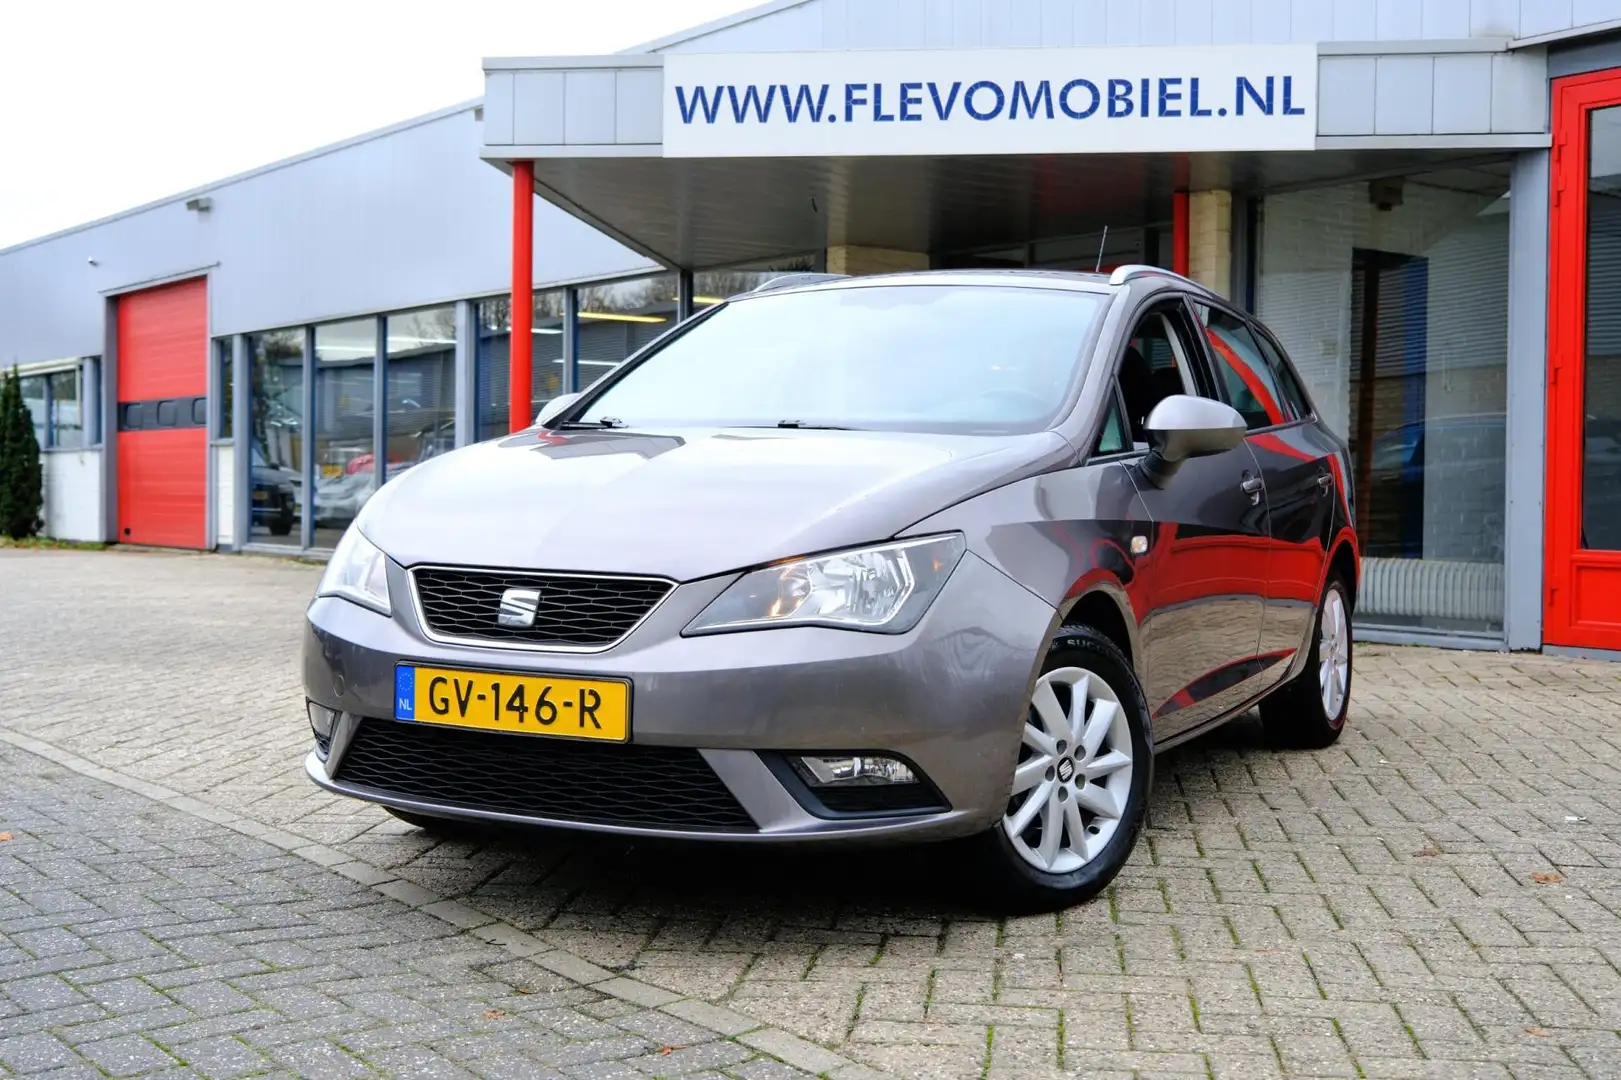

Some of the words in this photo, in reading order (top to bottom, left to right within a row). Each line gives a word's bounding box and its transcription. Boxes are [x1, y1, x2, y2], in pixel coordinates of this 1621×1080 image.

[675, 76, 1305, 124] WWW.FLEVOMOBIEL.NL
[399, 697, 412, 711] NL
[428, 676, 602, 729] GV-146-R
